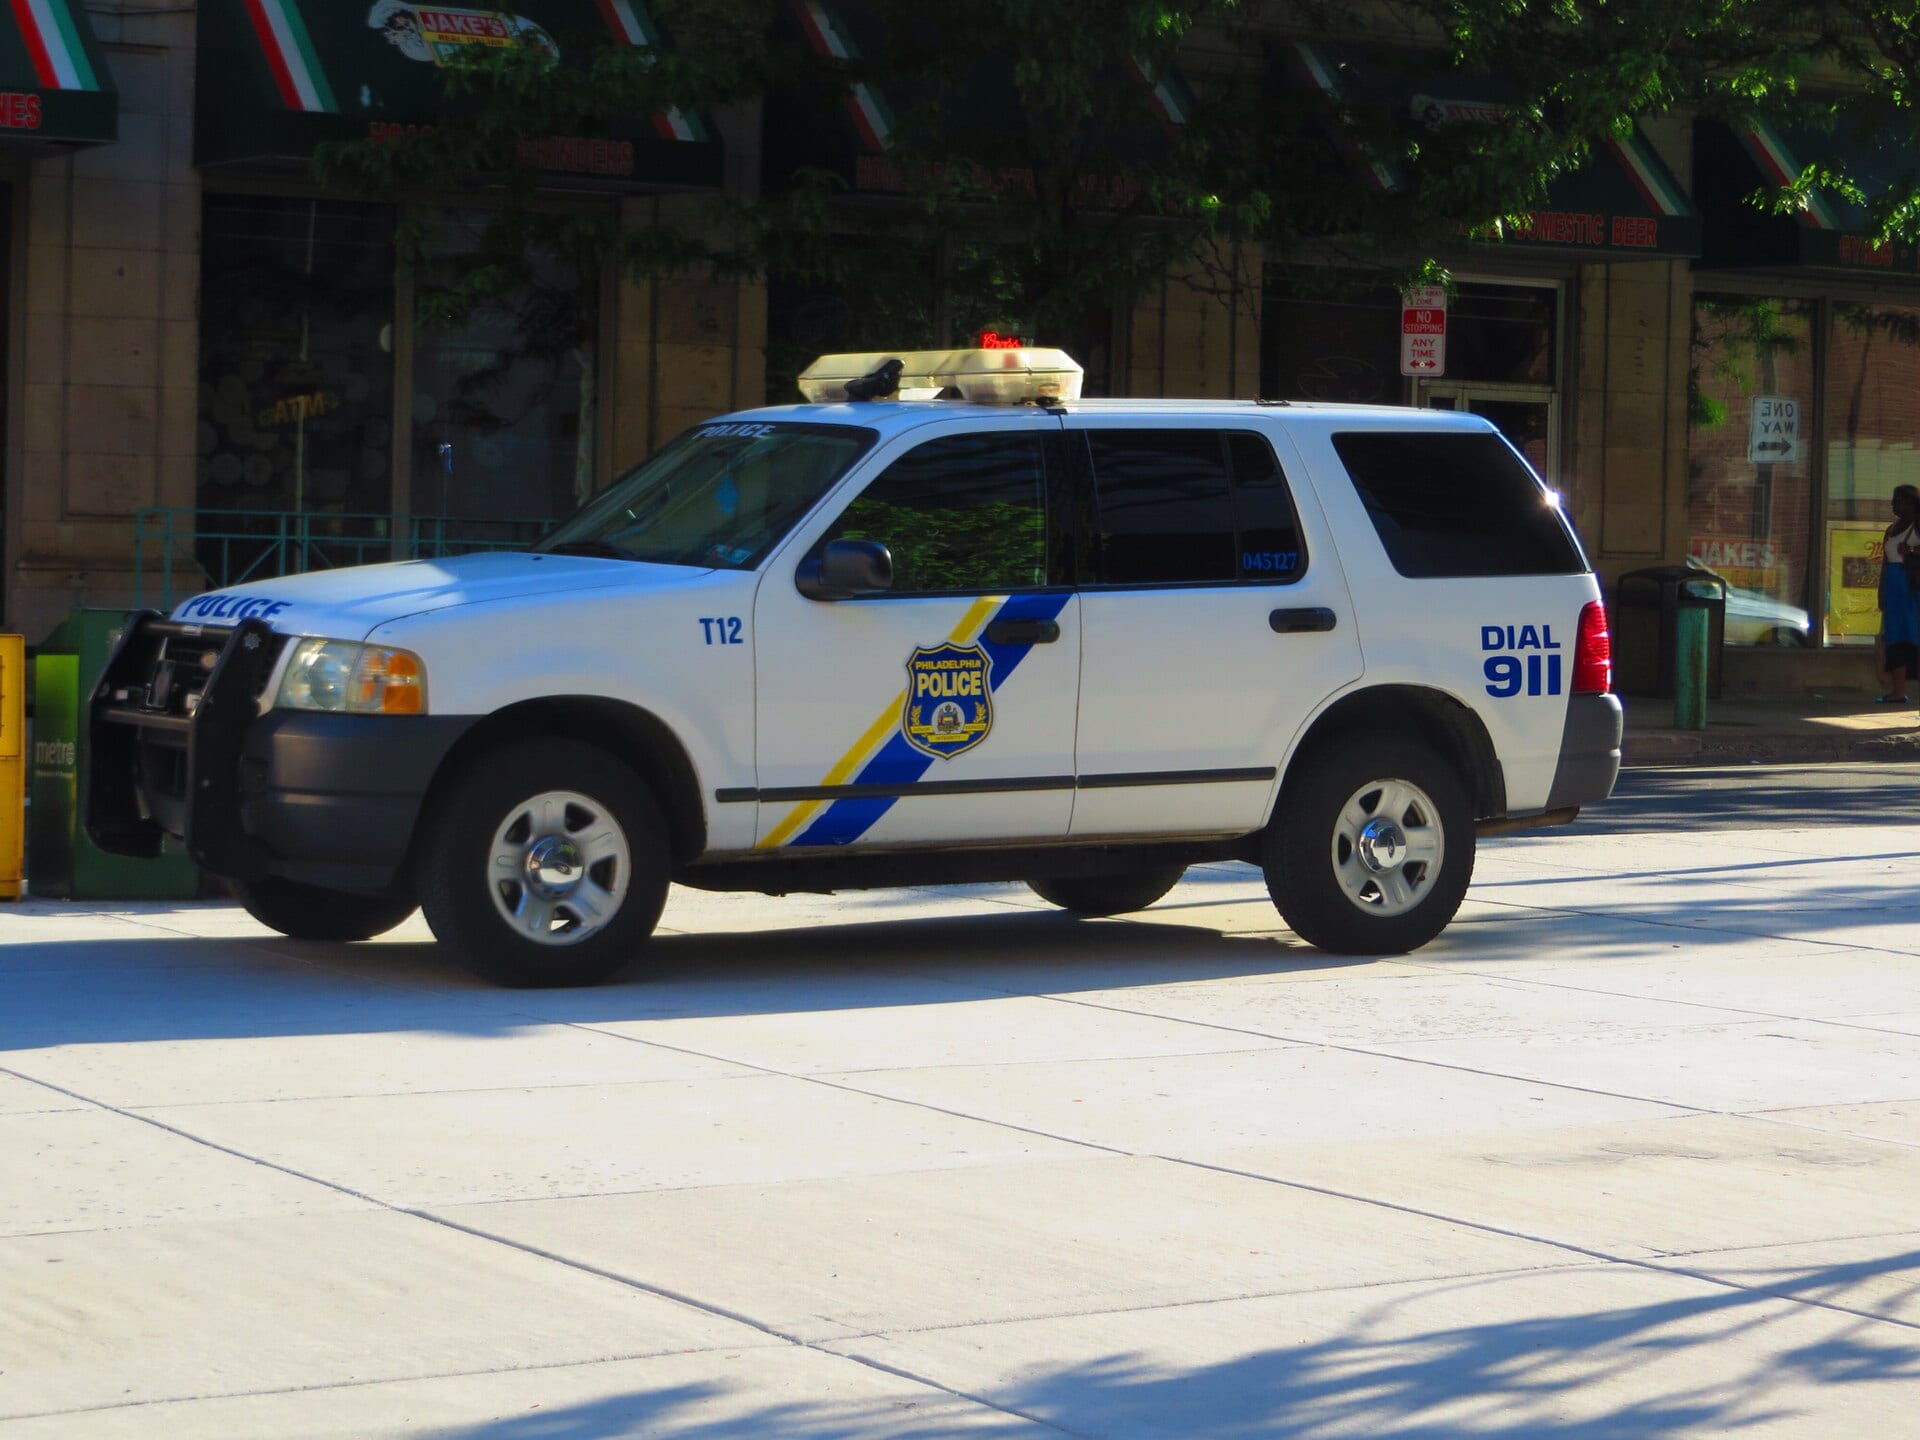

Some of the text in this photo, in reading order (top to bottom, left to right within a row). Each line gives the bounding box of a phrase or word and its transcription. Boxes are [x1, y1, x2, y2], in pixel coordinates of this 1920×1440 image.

[424, 13, 506, 38] JAKE'S
[1611, 216, 1658, 248] BEER
[1404, 323, 1443, 333] STOPPING
[1415, 310, 1432, 324] NO
[1411, 339, 1436, 347] ANY
[1411, 349, 1436, 359] TIME
[692, 424, 777, 439] POLICE
[1242, 551, 1297, 570] 045127
[182, 595, 292, 620] POLICE
[699, 616, 744, 645] T12
[1481, 625, 1561, 650] DIAL
[915, 659, 981, 669] PHILADELPHIA
[917, 671, 982, 697] POLICE
[1483, 655, 1561, 698] 911
